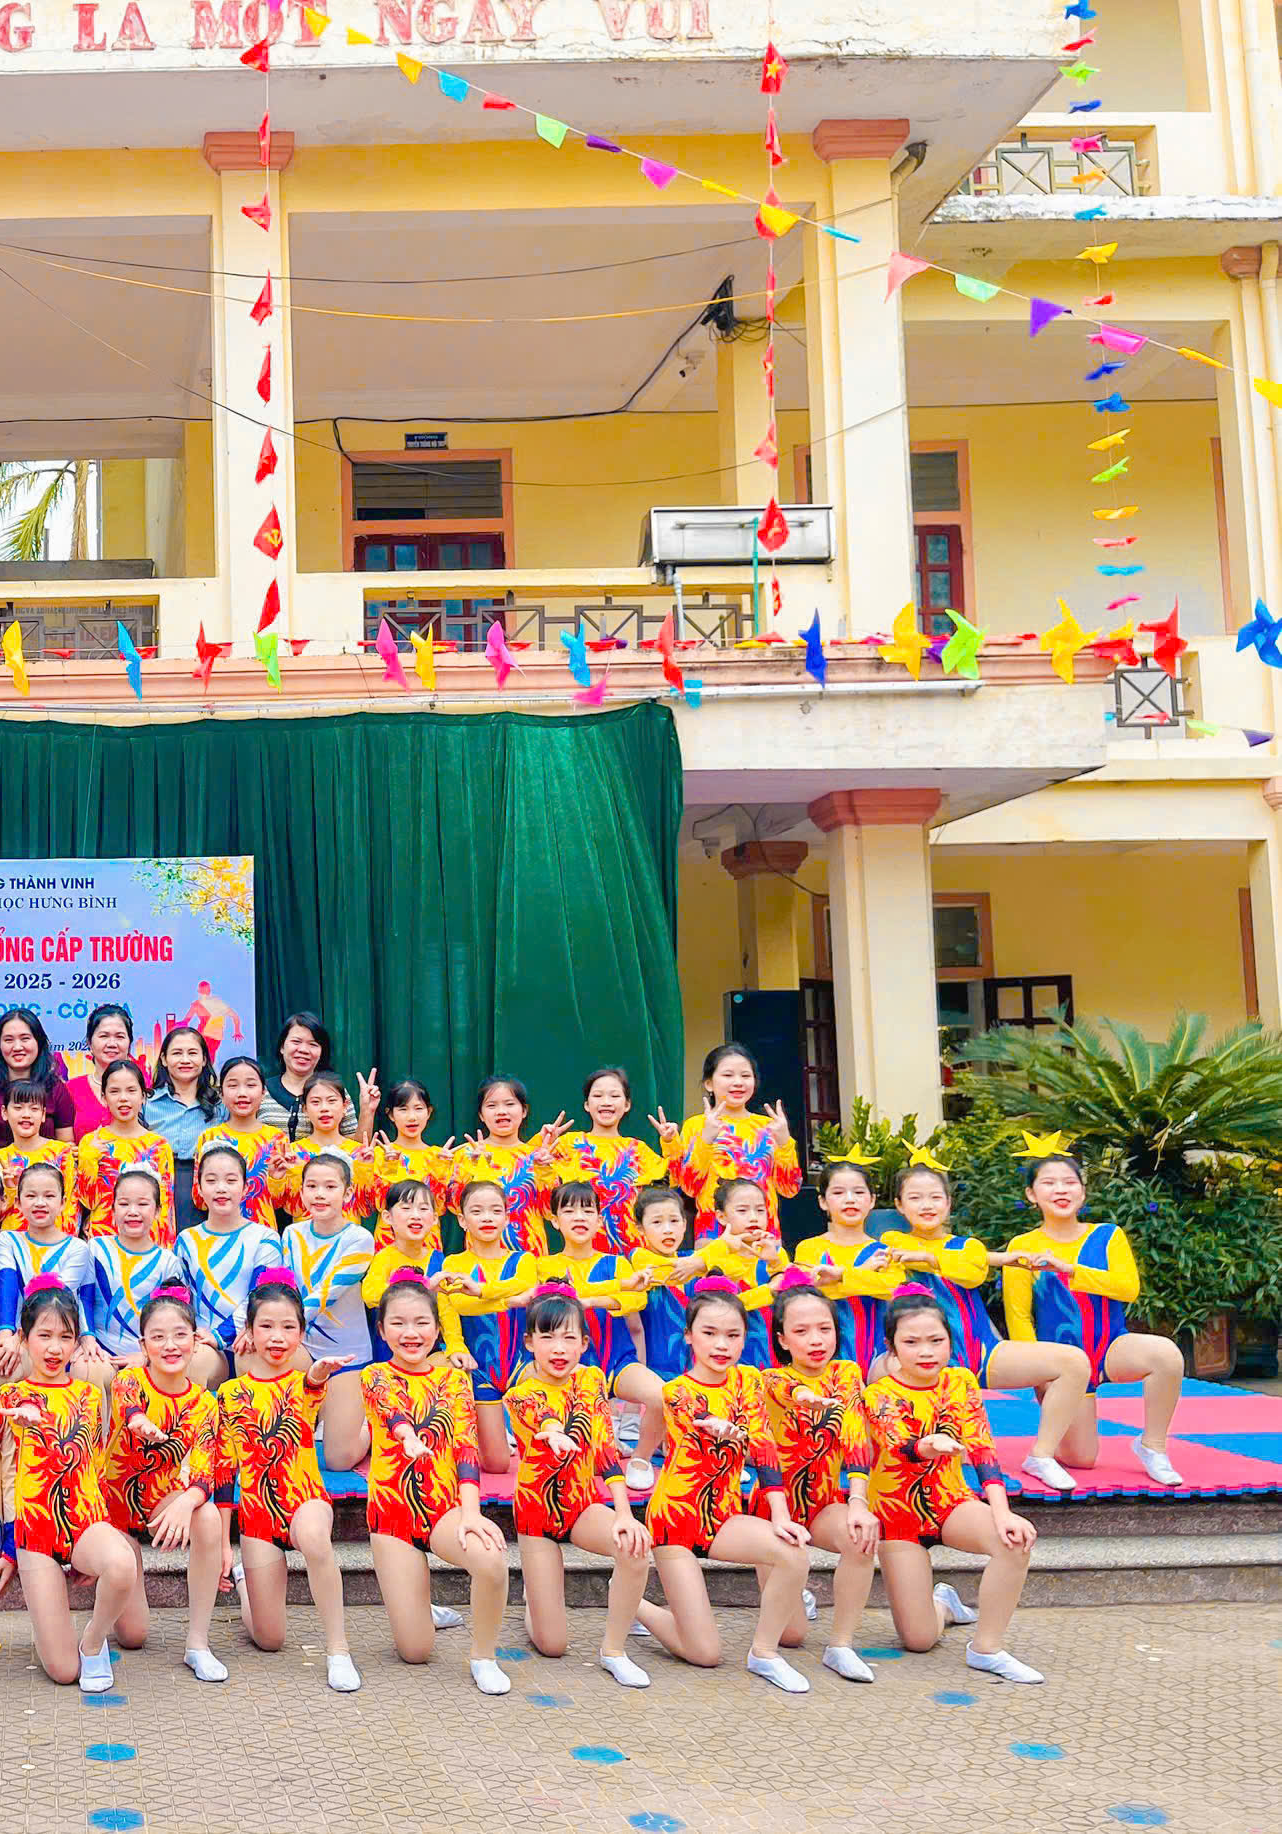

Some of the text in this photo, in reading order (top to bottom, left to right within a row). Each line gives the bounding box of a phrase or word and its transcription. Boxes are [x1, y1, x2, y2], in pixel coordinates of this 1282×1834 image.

[10, 876, 56, 889] THÀNH
[61, 878, 95, 889] VINH
[29, 896, 74, 910] HƯNG
[78, 894, 118, 909] BÌNH
[41, 927, 83, 962] CẤP
[89, 929, 173, 962] TRƯỜNG
[4, 973, 52, 989] 2025
[72, 973, 121, 989] 2026
[58, 999, 88, 1019] CỜ
